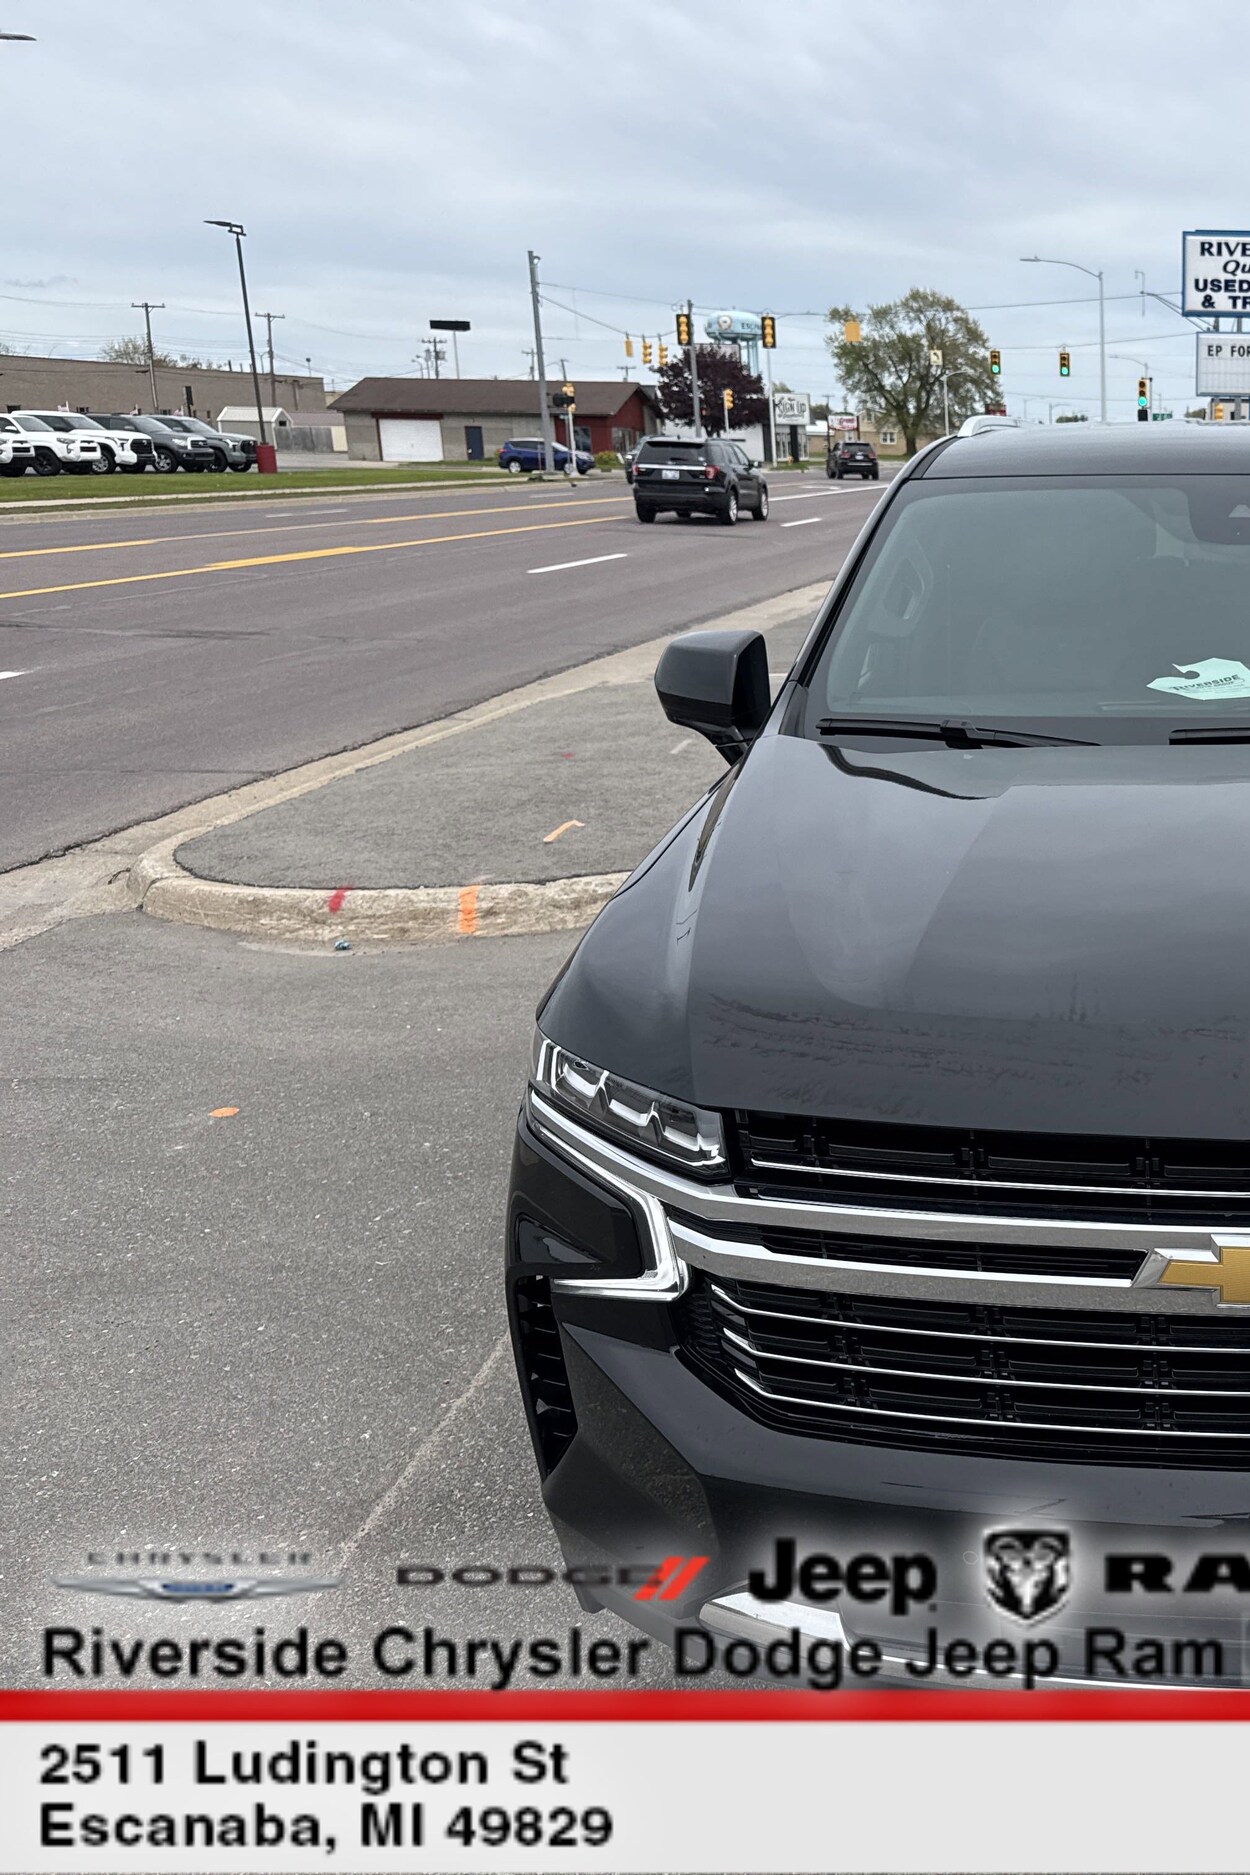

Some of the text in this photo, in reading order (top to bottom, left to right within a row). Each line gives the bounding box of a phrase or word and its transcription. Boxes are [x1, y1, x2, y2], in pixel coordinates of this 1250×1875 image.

[1201, 294, 1216, 309] &
[1207, 345, 1223, 357] EP
[1169, 674, 1241, 691] RIVERSIDE
